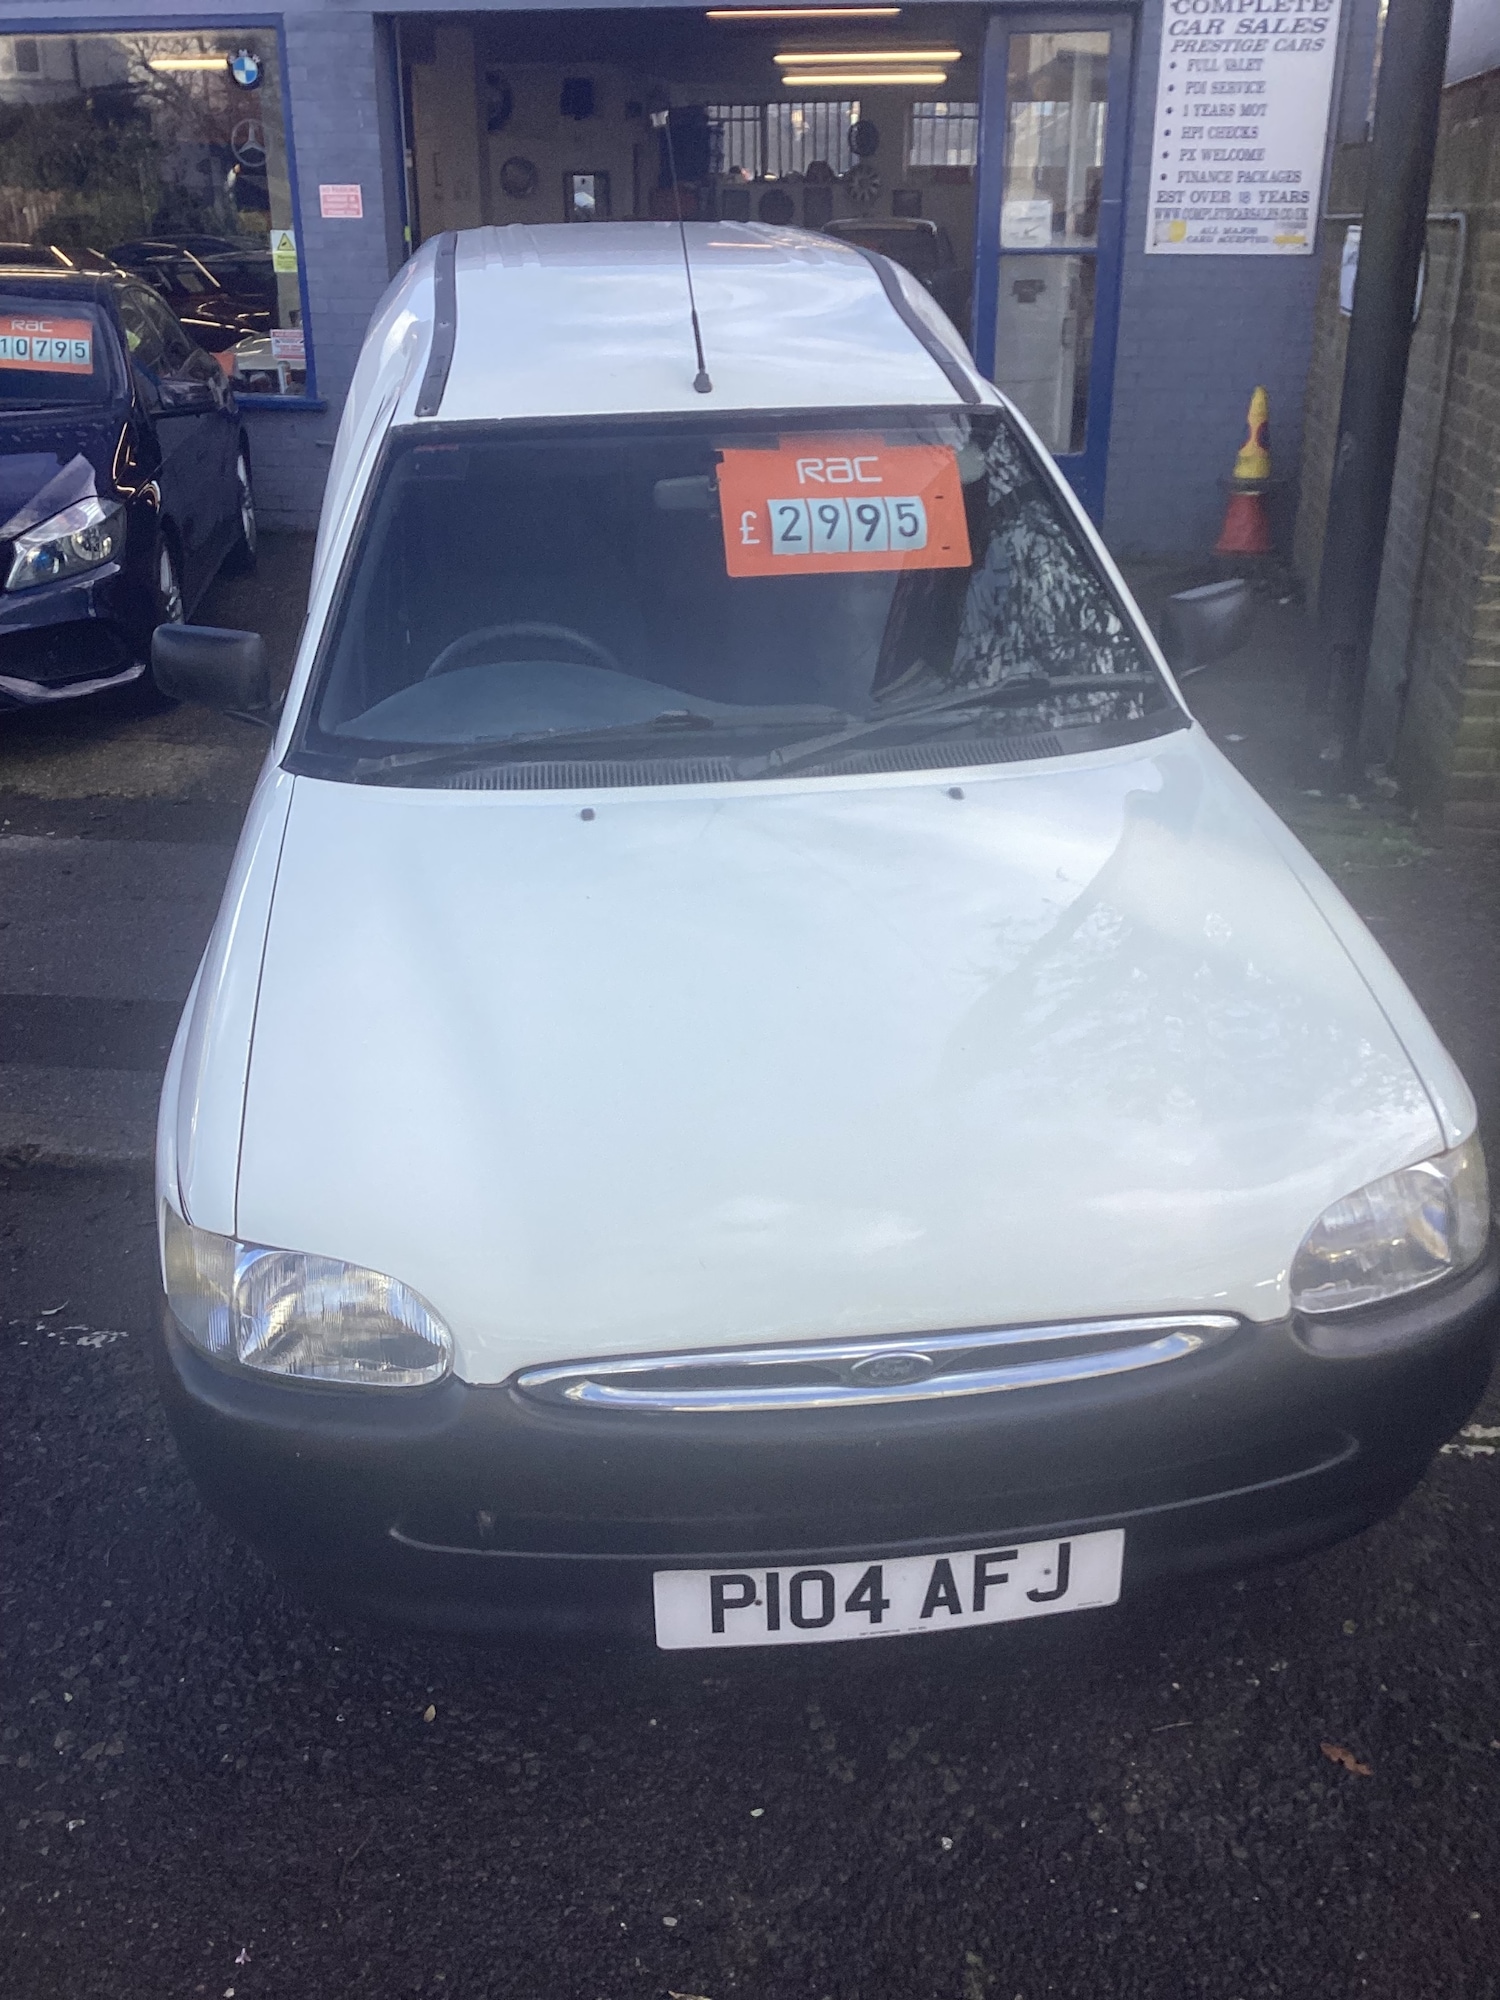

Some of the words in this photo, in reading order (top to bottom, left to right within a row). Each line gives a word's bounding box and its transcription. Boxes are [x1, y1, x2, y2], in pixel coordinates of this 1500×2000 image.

[1171, 0, 1333, 14] COMPLETE
[1169, 18, 1225, 36] CAR
[1235, 17, 1329, 34] SALES
[1170, 39, 1269, 53] PRESTIGE
[1273, 38, 1325, 52] CARS
[1187, 58, 1219, 71] FULL
[1224, 58, 1264, 71] VALET
[1210, 80, 1266, 94] SERVICE
[1194, 103, 1236, 117] YEARS
[1239, 103, 1268, 117] MOT
[1181, 125, 1204, 139] HPI
[1207, 125, 1259, 139] CHECKS
[1179, 148, 1197, 161] PX
[1201, 148, 1265, 161] WELCOME
[1177, 170, 1233, 183] FINANCE
[1236, 170, 1303, 183] PACKAGES
[1156, 190, 1186, 203] EST
[1189, 190, 1231, 203] OVER
[1258, 190, 1311, 203] YEARS
[0, 338, 86, 358] 10795
[738, 510, 761, 545] £
[778, 503, 921, 543] 2995
[709, 1564, 891, 1634] P104
[919, 1541, 1073, 1620] AFJ
